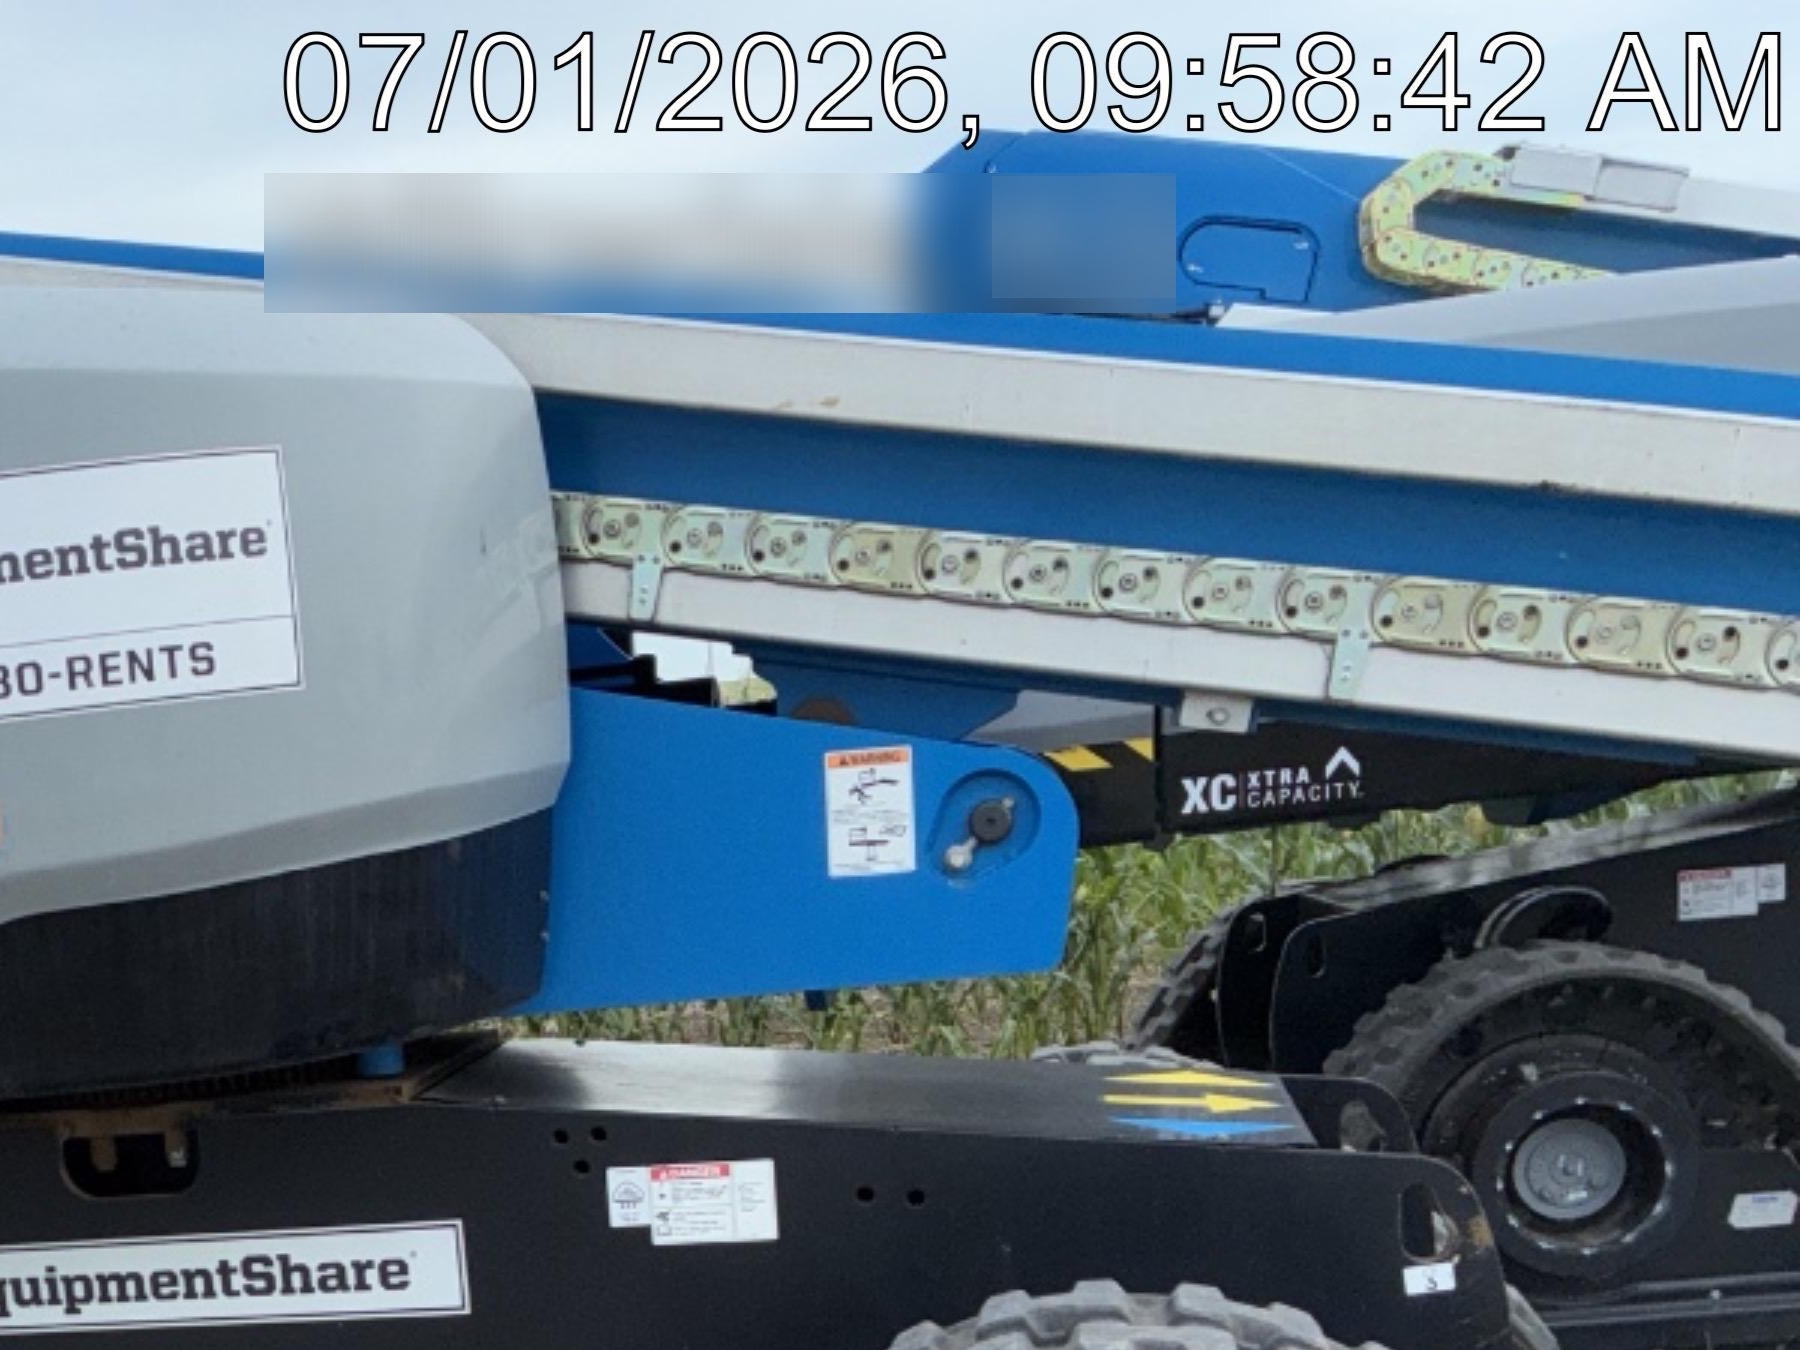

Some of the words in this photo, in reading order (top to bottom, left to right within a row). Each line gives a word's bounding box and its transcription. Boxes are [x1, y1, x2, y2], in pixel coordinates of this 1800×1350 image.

[1247, 765, 1311, 790] XTRA
[1180, 773, 1238, 815] XC
[1247, 780, 1361, 809] CAPACITY
